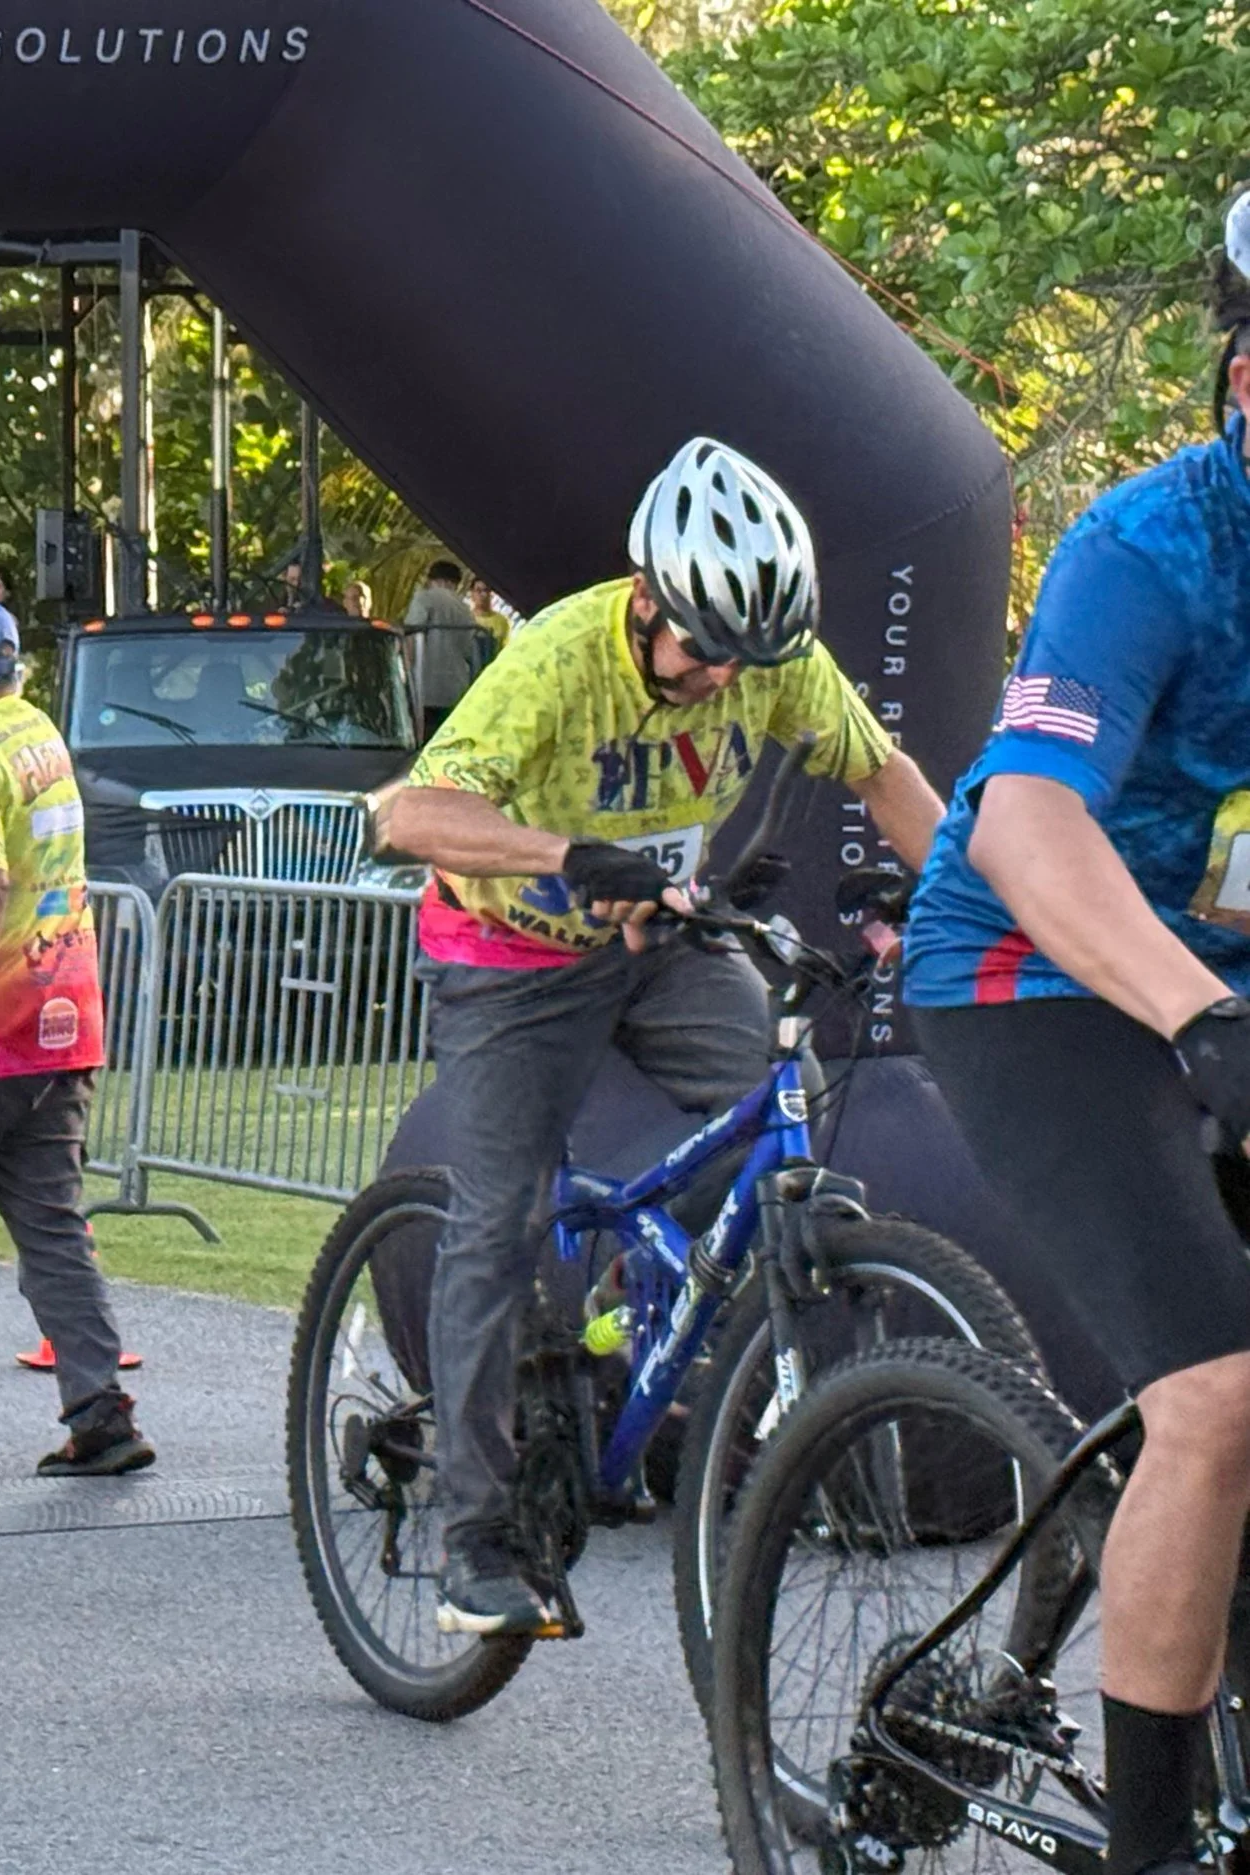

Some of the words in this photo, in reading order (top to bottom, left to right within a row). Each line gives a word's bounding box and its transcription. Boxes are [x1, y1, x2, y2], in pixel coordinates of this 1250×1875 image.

[883, 565, 914, 676] YOUR
[507, 903, 598, 949] WALK
[966, 1802, 1058, 1856] BRAVO
